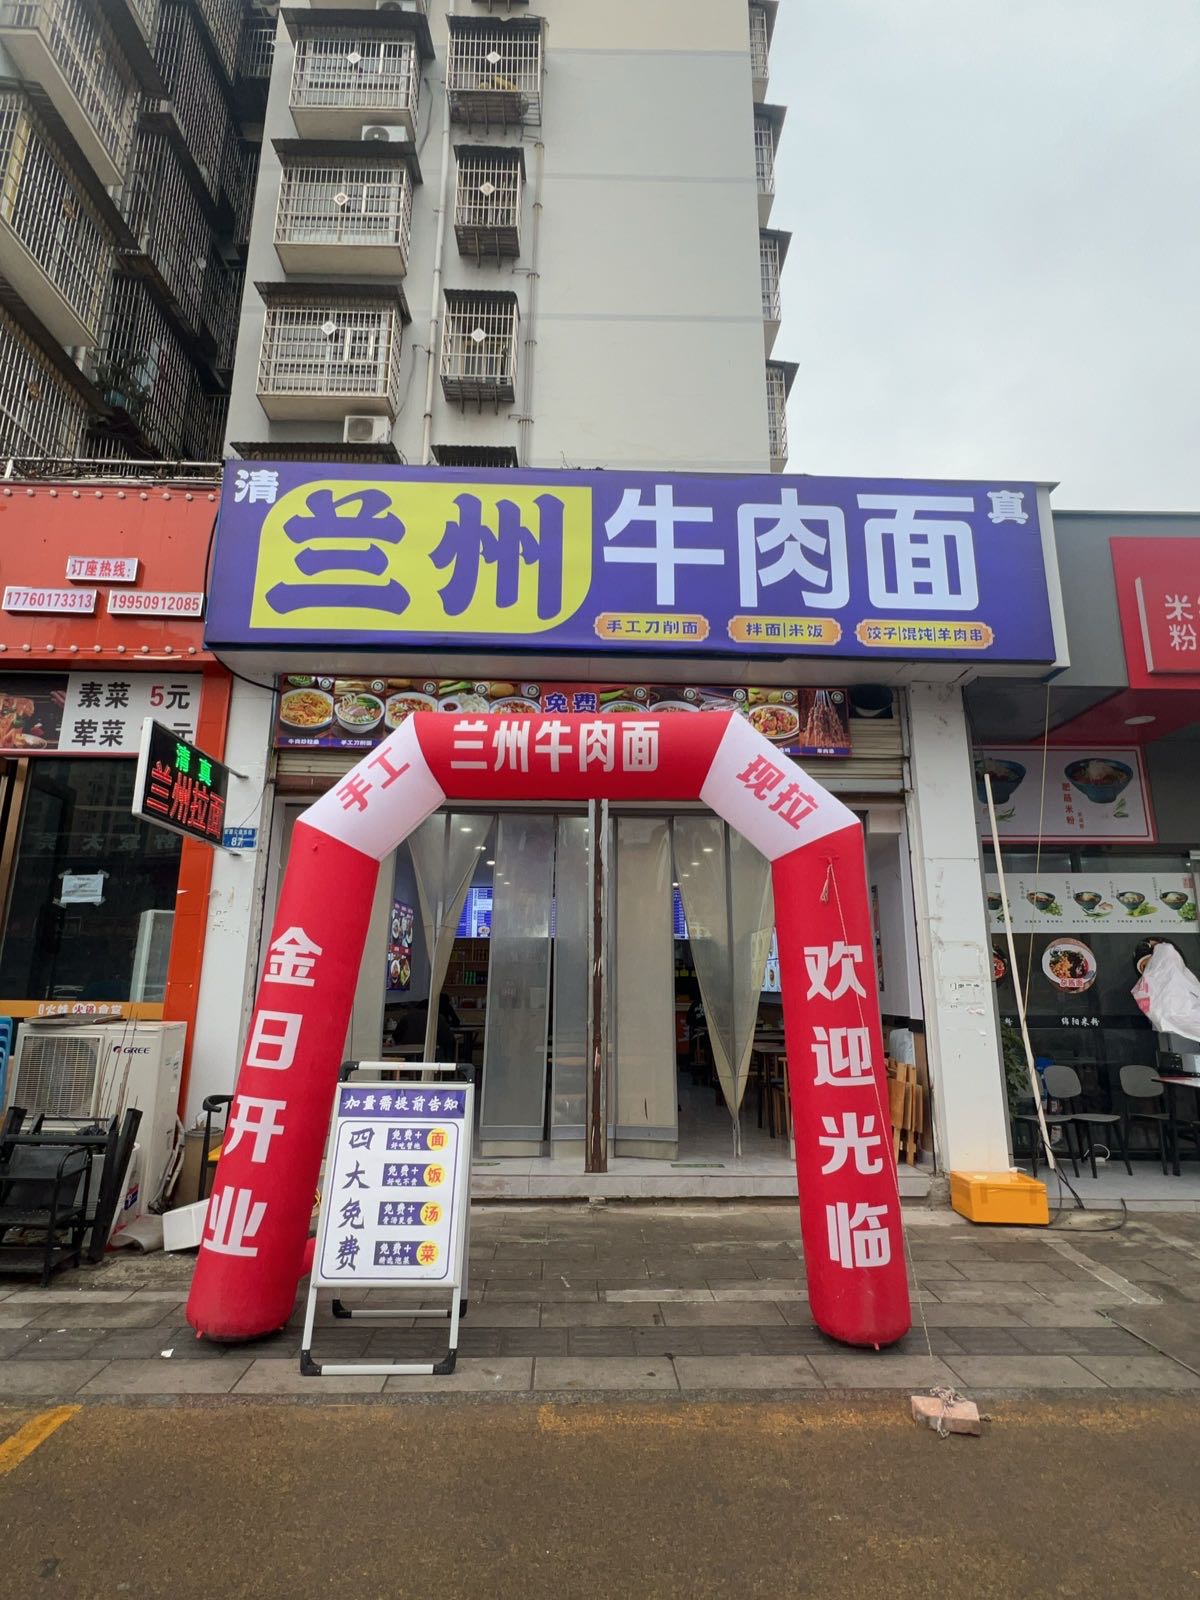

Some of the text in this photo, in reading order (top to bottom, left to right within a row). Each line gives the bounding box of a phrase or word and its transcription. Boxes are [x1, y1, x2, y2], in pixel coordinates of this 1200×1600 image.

[234, 469, 279, 504] 清
[987, 490, 1028, 524] 真
[265, 484, 979, 620] 兰州 牛肉面
[6, 591, 93, 608] 17760173313
[112, 594, 200, 611] 19950912085
[606, 619, 699, 635] 手工刀削面
[77, 681, 191, 710] 素菜 5元
[544, 692, 597, 713] 免费
[71, 719, 126, 747] 荤菜
[450, 719, 660, 773] 兰州牛肉面
[176, 743, 212, 786] 清真
[336, 746, 410, 812] 手工
[147, 760, 225, 839] 兰州拉面
[735, 754, 819, 830] 现拉
[1062, 782, 1075, 825] 肥肠米粉
[1061, 1017, 1100, 1026] 绵阳米粉
[203, 926, 323, 1258] 金日开业
[343, 1094, 459, 1112] 加量需提前告知
[804, 941, 891, 1269] 欢迎光临
[431, 1131, 445, 1147] 面
[427, 1167, 441, 1184] 饭
[335, 1127, 375, 1271] 四大免费
[425, 1206, 439, 1223] 汤
[420, 1245, 436, 1262] 菜
